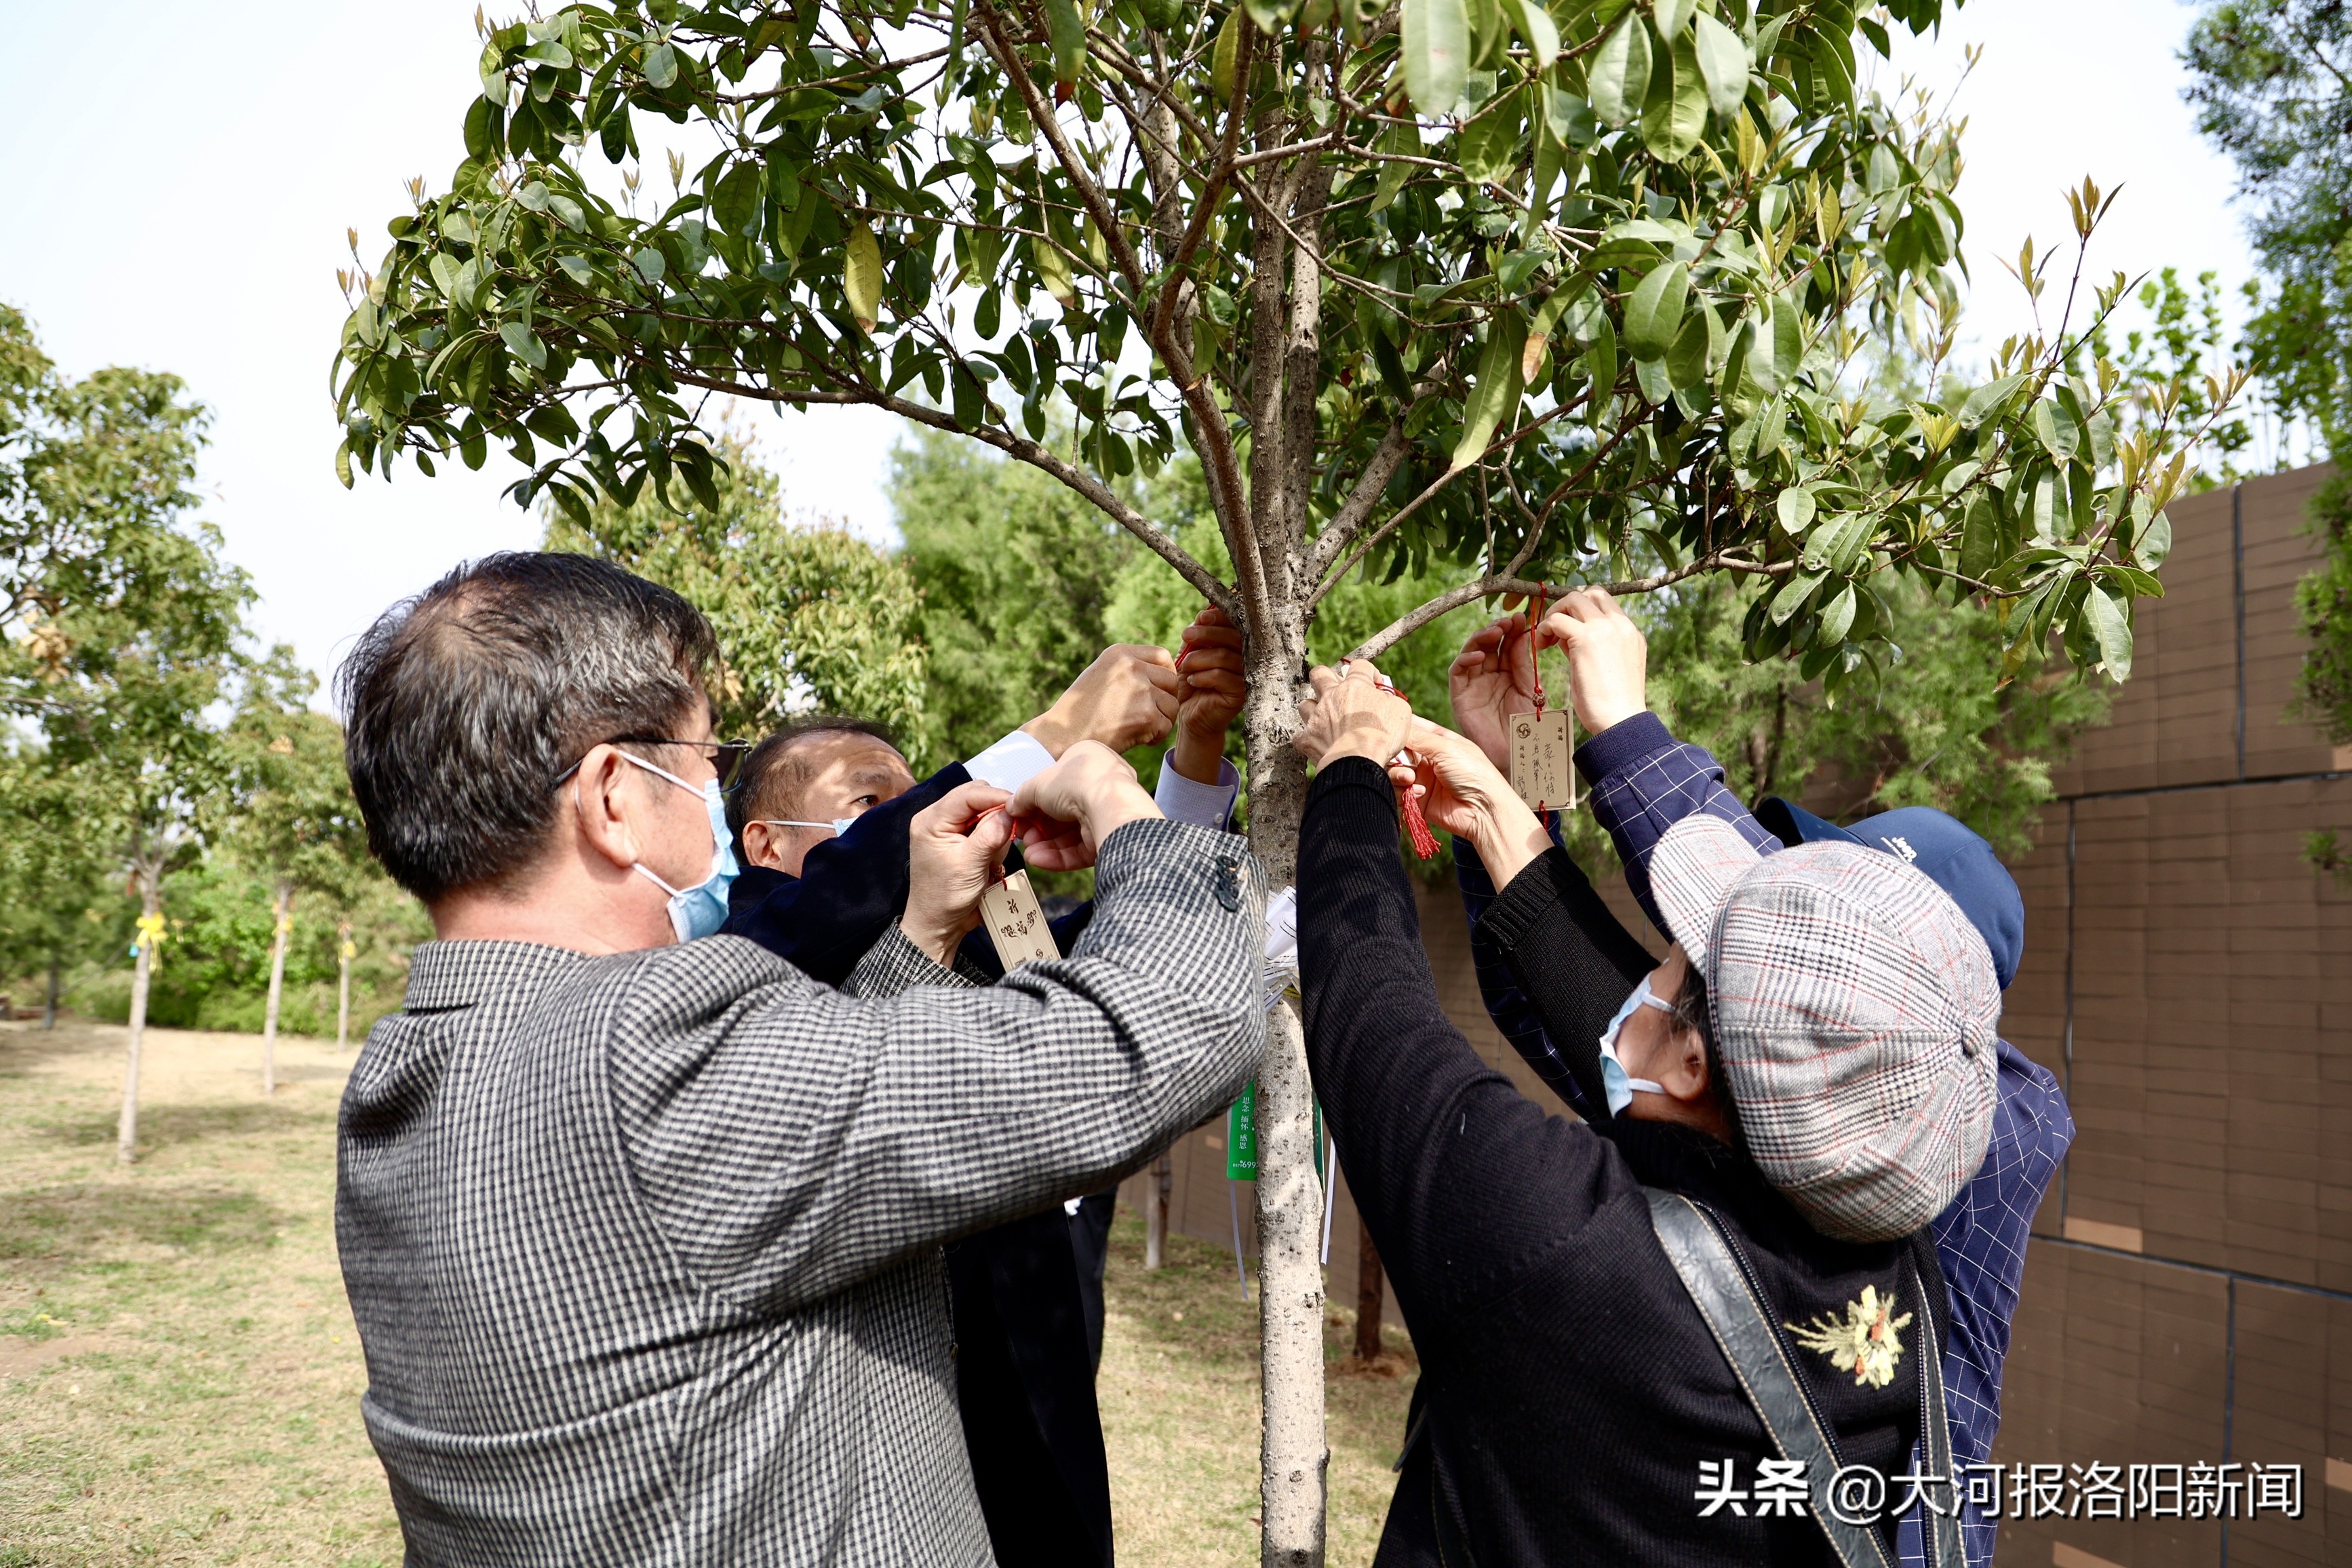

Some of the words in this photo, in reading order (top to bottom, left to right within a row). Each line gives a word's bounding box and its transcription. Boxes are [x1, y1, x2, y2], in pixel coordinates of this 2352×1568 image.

[1006, 899, 1027, 935] 祈福
[1241, 1097, 1250, 1112] 思念
[1240, 1115, 1249, 1131] 缅怀
[1239, 1134, 1247, 1150] 感恩
